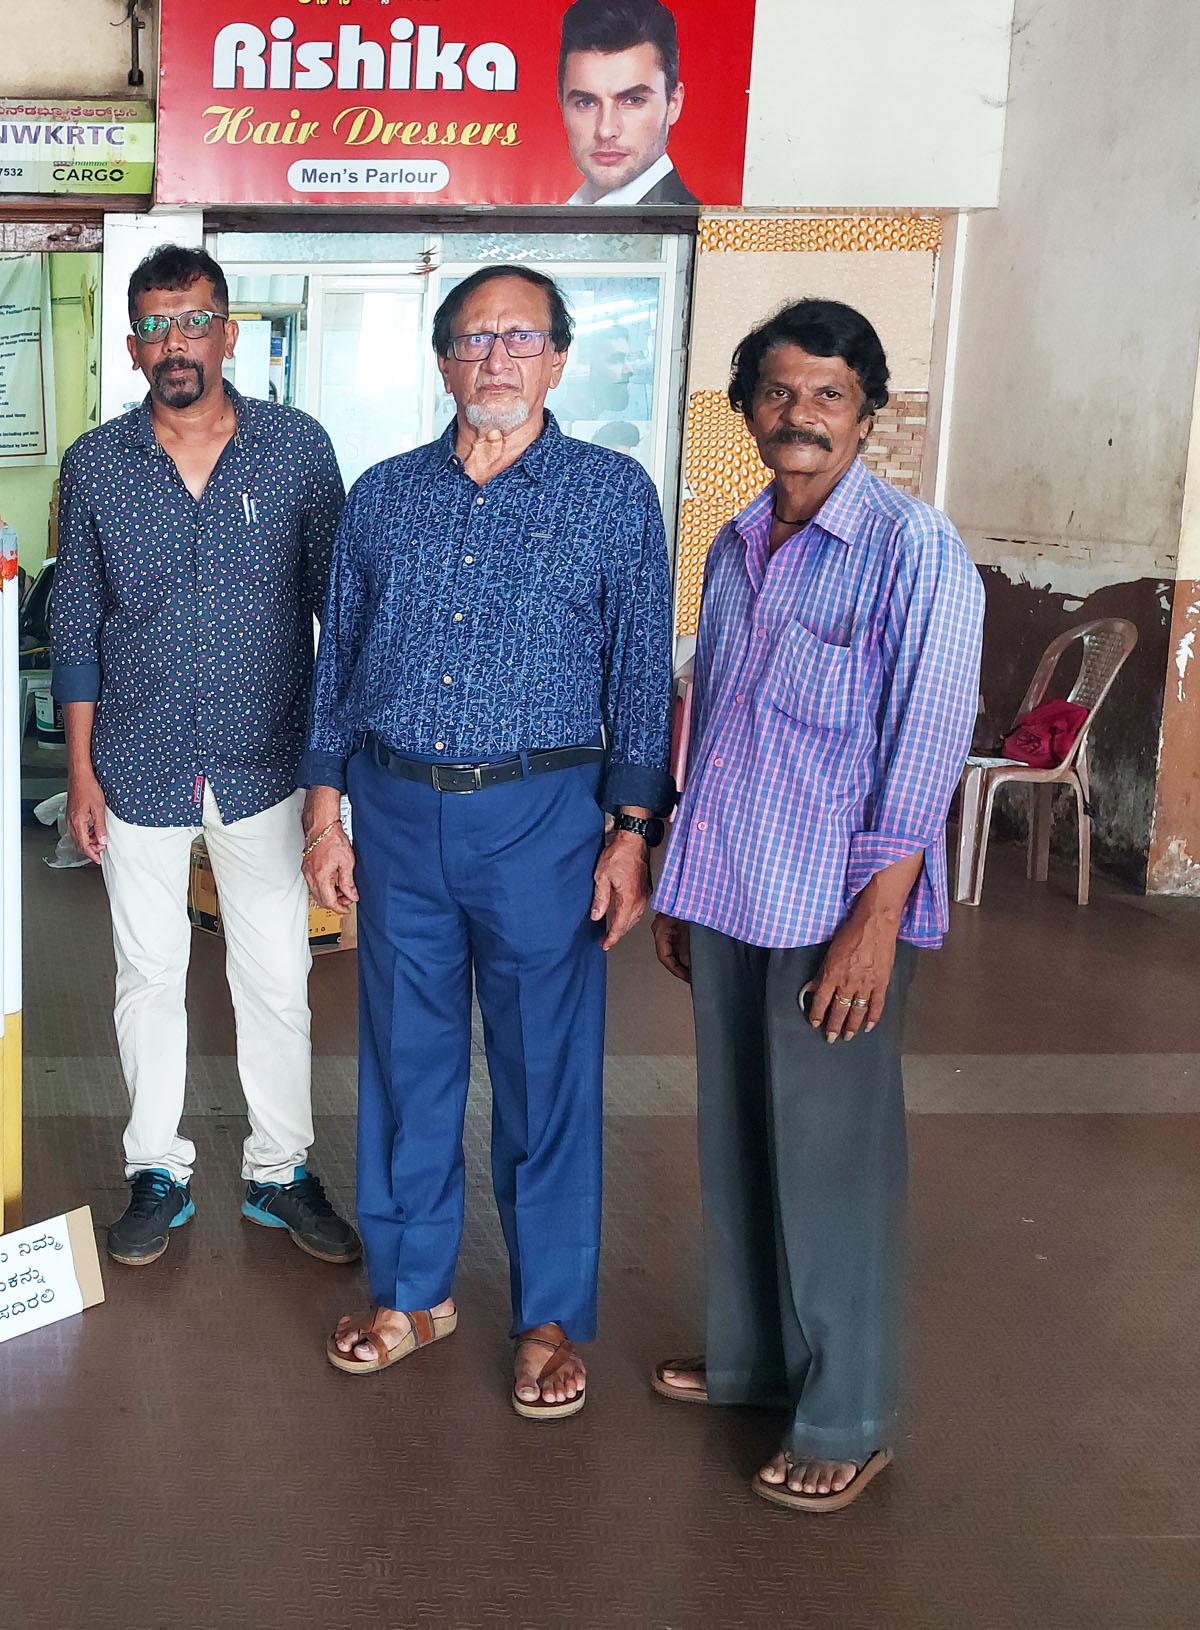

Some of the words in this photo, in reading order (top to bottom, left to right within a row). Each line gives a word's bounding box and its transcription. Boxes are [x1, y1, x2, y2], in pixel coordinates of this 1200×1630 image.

[212, 16, 517, 92] Rishika
[201, 105, 319, 147] Hair
[332, 105, 523, 147] Dressers
[52, 168, 124, 182] CARGO
[366, 167, 438, 185] Parlour
[18, 1233, 64, 1257] ನಿಮ್ಮ
